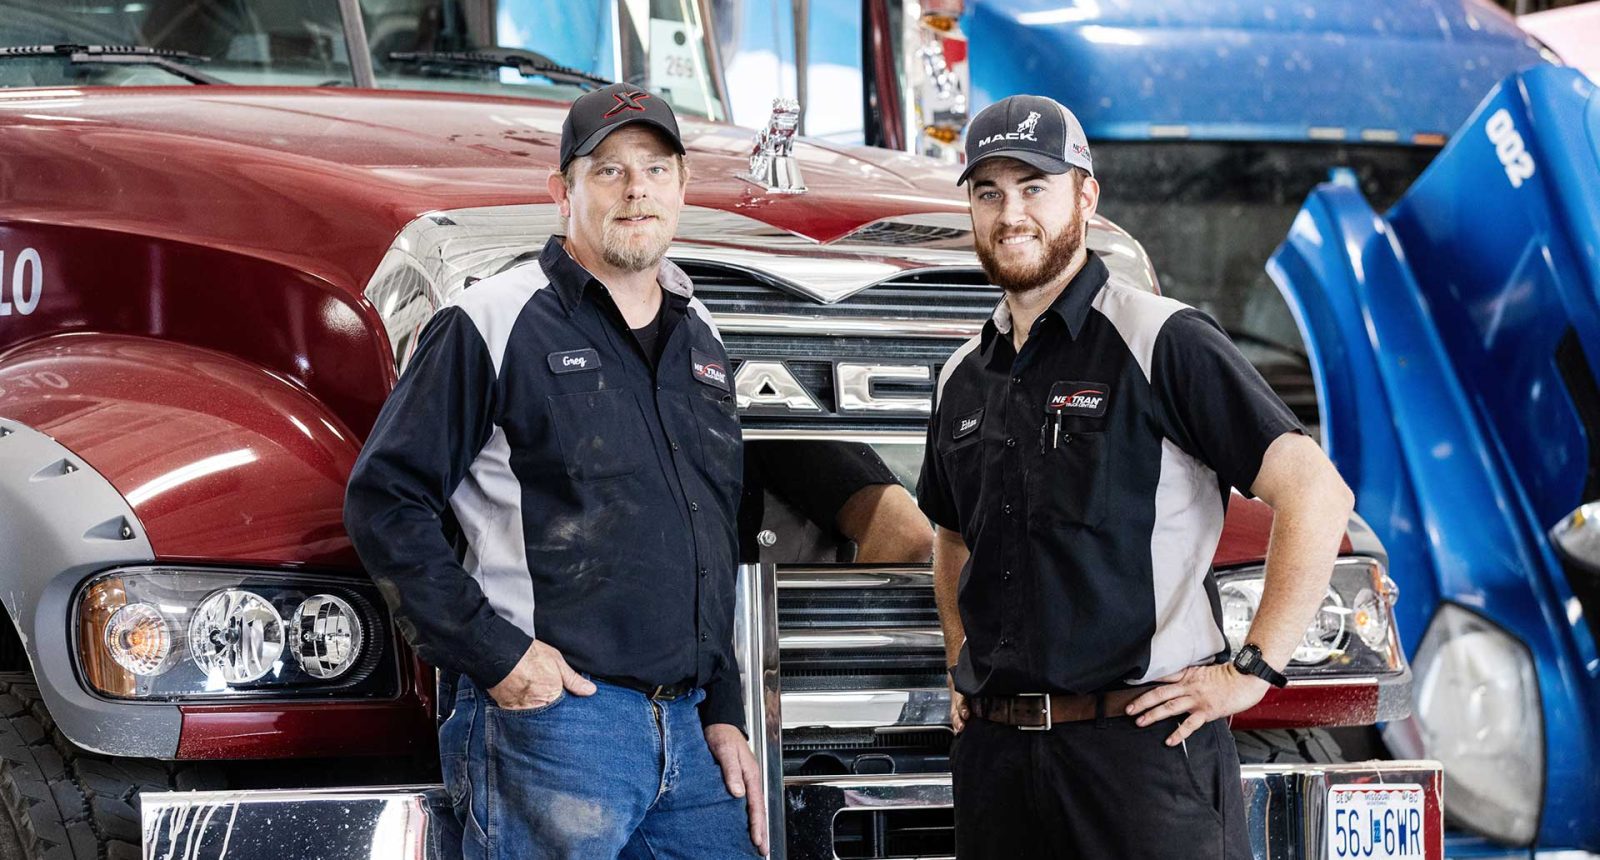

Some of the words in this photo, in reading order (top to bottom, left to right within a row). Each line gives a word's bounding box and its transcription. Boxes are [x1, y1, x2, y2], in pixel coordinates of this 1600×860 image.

[978, 132, 1037, 147] MACK
[562, 356, 587, 368] Greg
[734, 360, 932, 413] AC
[1051, 395, 1102, 407] NEXTRAN
